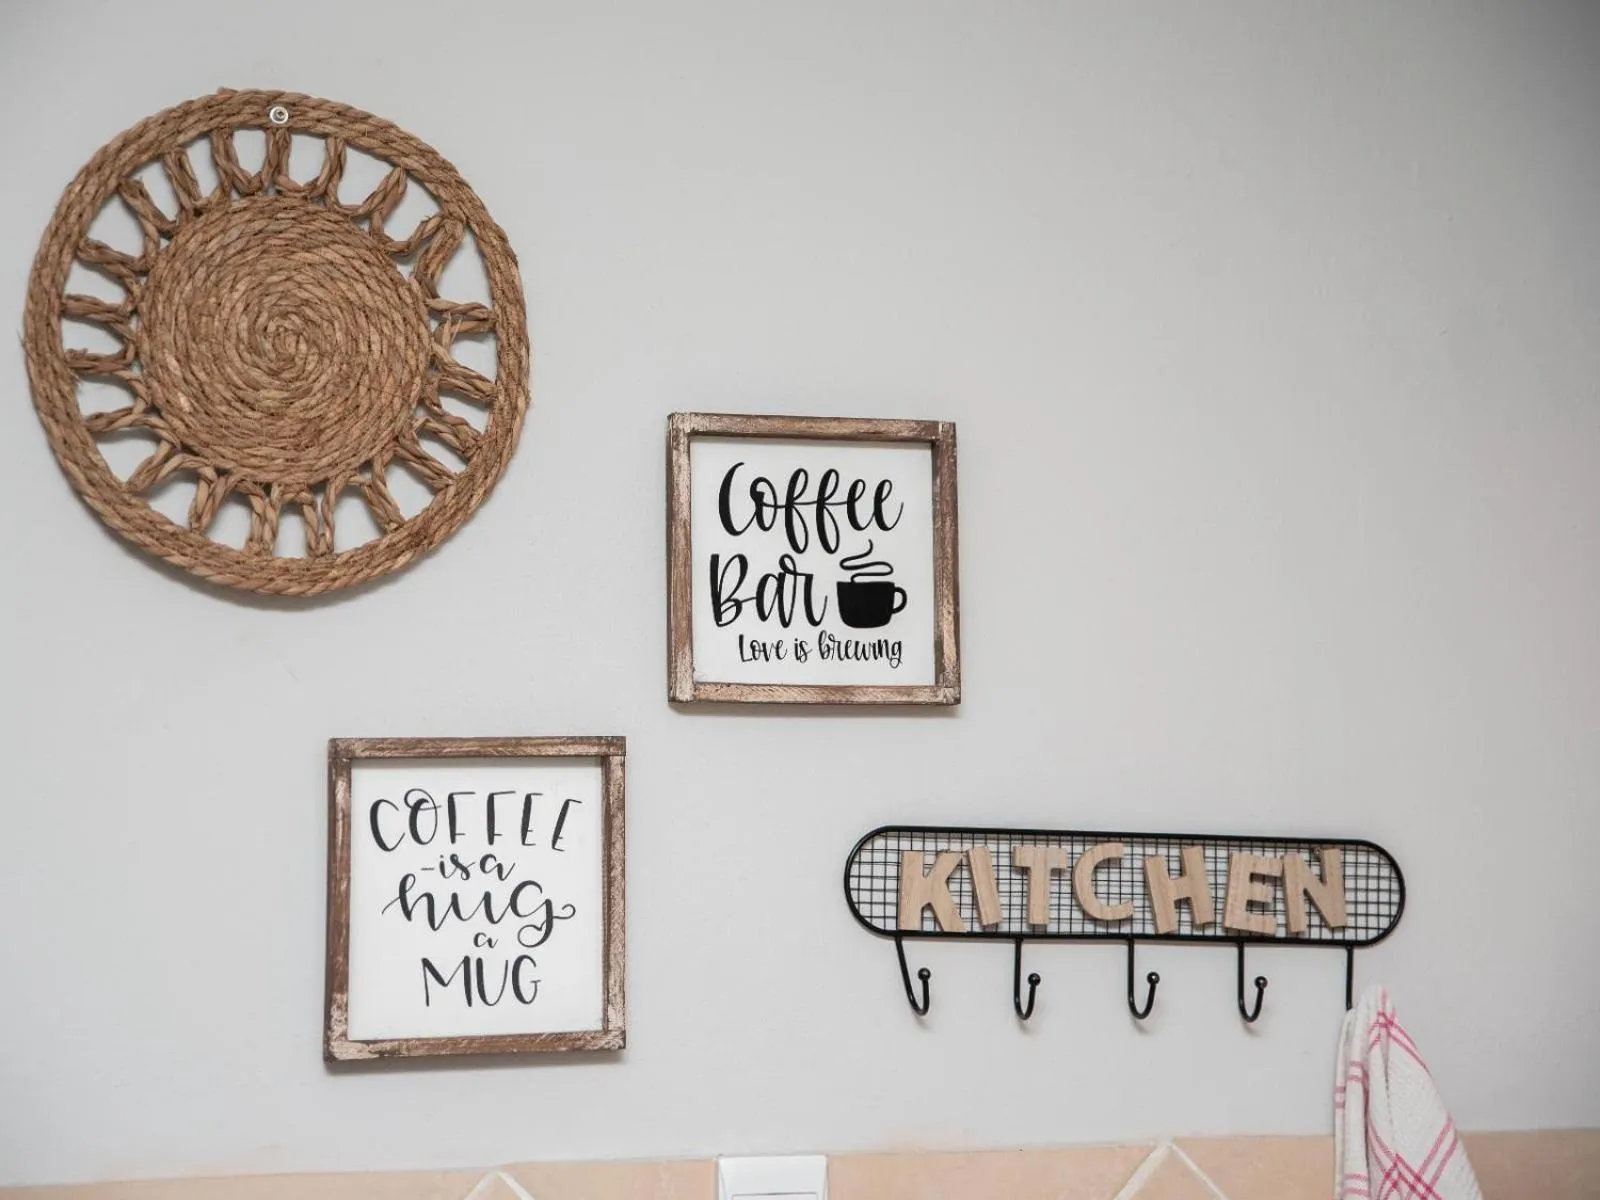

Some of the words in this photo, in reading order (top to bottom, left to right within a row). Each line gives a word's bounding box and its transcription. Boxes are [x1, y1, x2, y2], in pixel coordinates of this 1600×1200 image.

[718, 461, 904, 554] Coffee
[709, 553, 828, 629] Bar
[738, 633, 788, 663] Love
[793, 637, 812, 663] is
[818, 630, 903, 669] brewing
[369, 788, 583, 852] COFFEE
[479, 853, 516, 881] a
[899, 842, 1347, 935] KITCHEN
[381, 873, 577, 949] hug
[473, 932, 499, 949] a
[421, 954, 542, 1008] MUG
